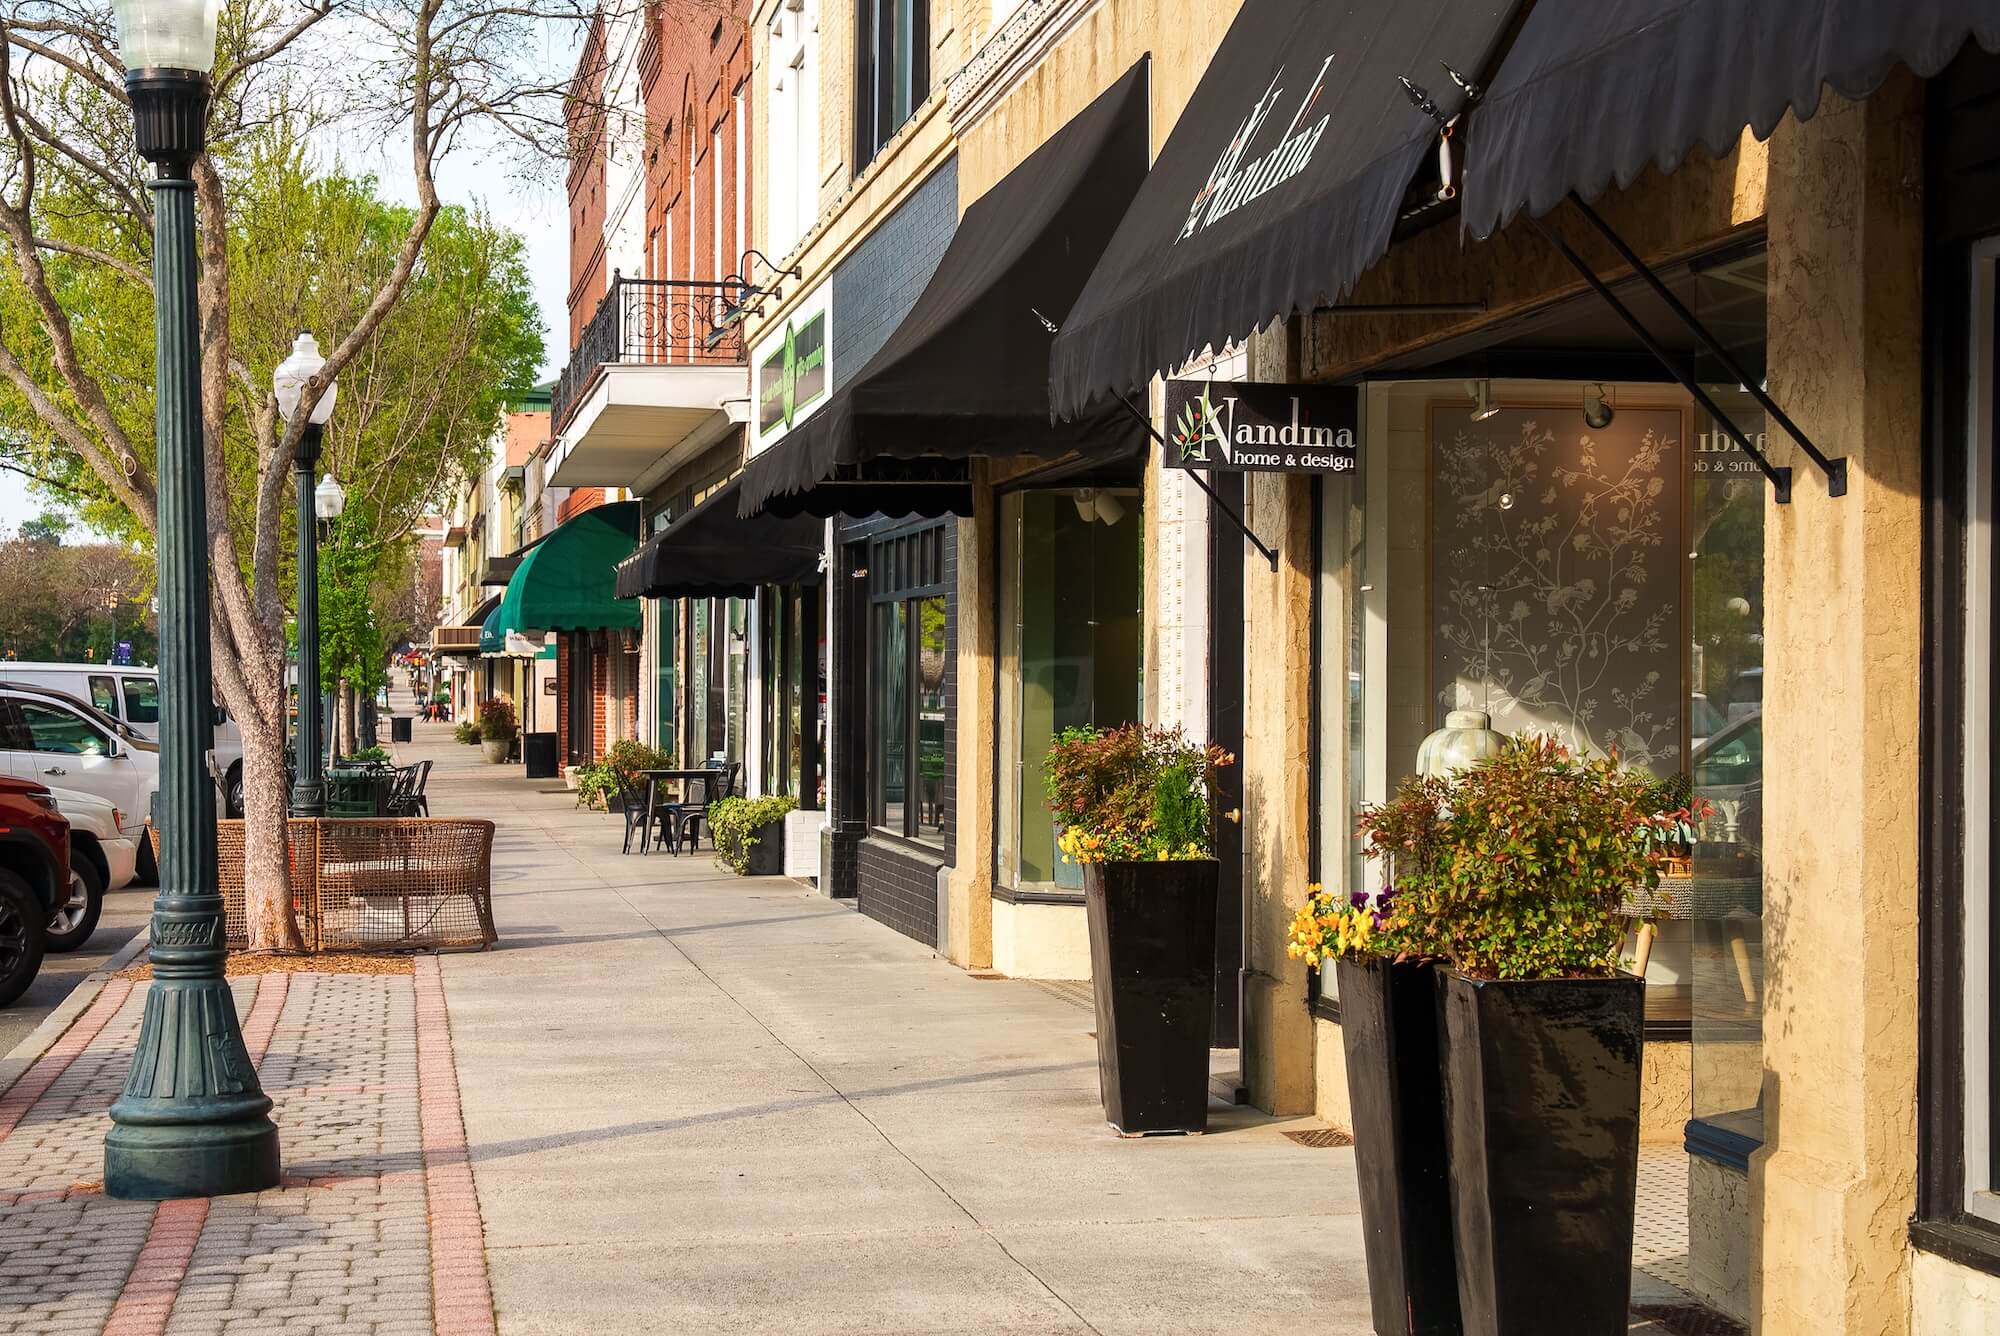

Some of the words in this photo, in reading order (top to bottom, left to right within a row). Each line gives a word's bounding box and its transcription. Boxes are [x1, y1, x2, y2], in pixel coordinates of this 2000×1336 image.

[1194, 395, 1356, 465] Nandina
[1233, 450, 1280, 466] home
[1285, 453, 1297, 467] &
[1301, 452, 1355, 471] design
